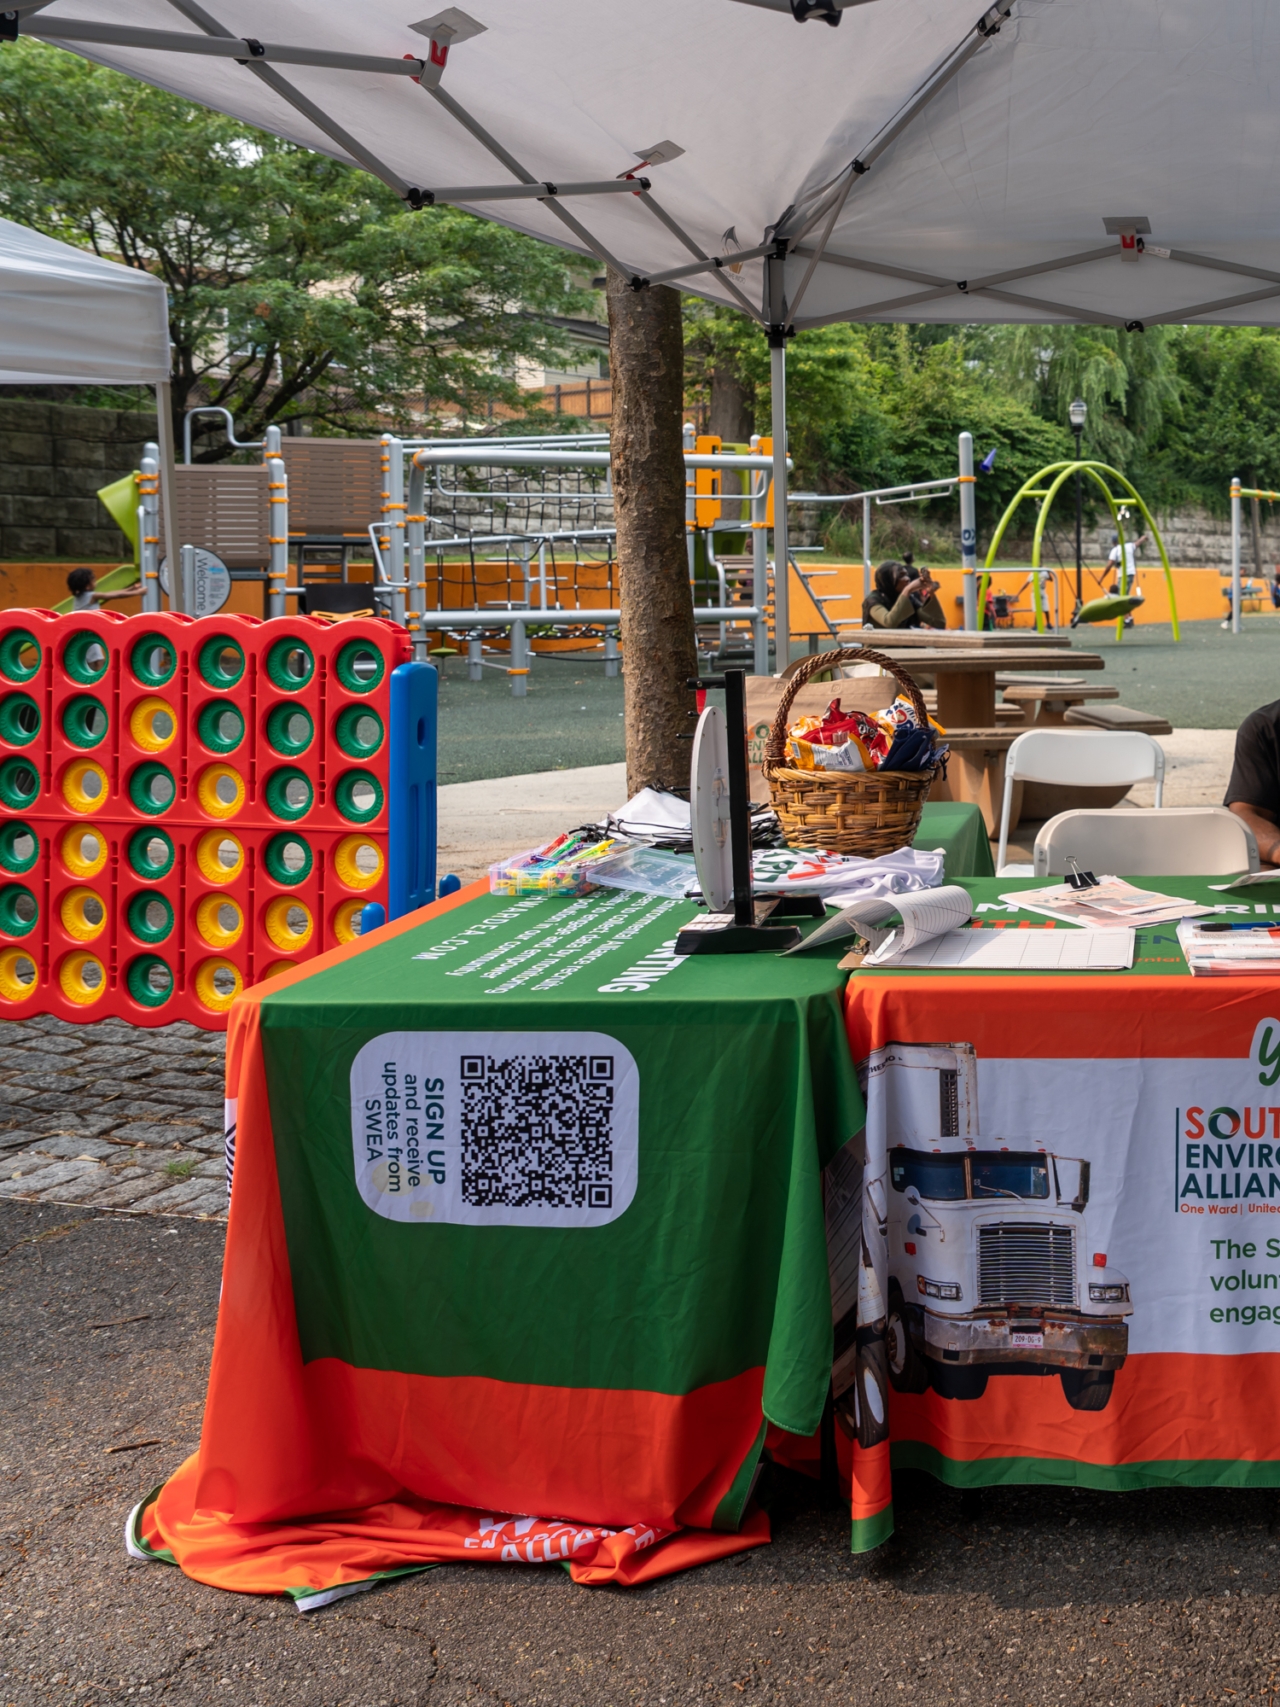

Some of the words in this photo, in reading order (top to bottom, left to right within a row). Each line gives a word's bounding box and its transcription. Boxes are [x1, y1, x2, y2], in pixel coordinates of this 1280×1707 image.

[197, 557, 209, 611] Welcome
[514, 929, 541, 941] our
[554, 913, 598, 938] engage
[566, 933, 600, 949] data
[589, 914, 629, 935] collect
[445, 940, 522, 977] community
[533, 935, 564, 949] and
[572, 939, 625, 966] Alliance
[480, 948, 541, 979] empower
[484, 957, 561, 995] monitoring
[530, 964, 584, 992] recruits
[382, 1061, 400, 1142] updates
[404, 1073, 421, 1110] and
[424, 1077, 444, 1141] SIGN
[365, 1098, 382, 1163] SWEA
[406, 1115, 423, 1188] receive
[427, 1150, 446, 1185] UP
[386, 1148, 402, 1194] from
[1180, 1202, 1205, 1215] One
[1210, 1238, 1257, 1260] The
